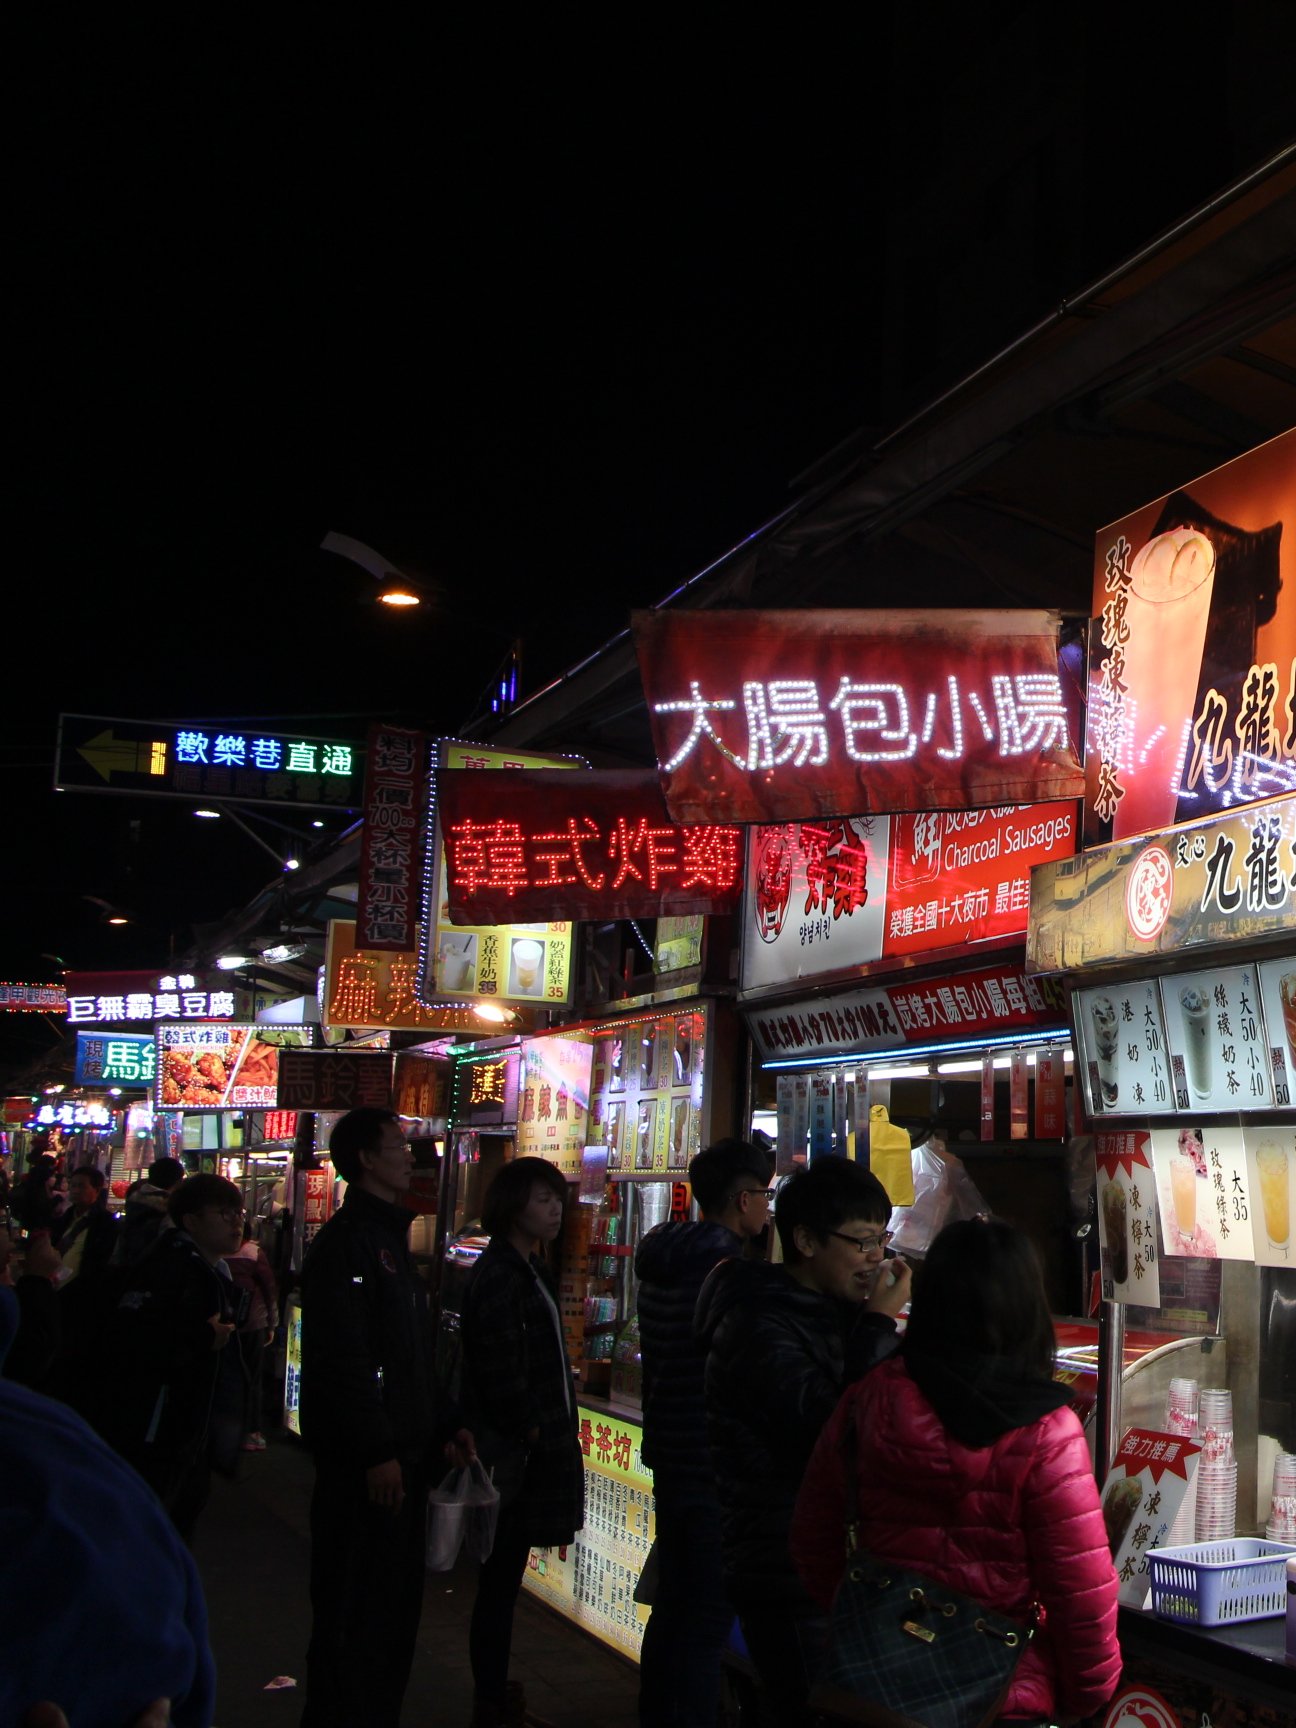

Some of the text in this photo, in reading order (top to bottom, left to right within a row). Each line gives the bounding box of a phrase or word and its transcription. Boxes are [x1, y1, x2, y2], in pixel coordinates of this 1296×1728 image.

[655, 674, 1069, 772] 大腸包小腸
[176, 732, 353, 777] 歡樂巷直通
[452, 818, 741, 896] 韓式炸雞
[944, 828, 1001, 871] Charcoal
[1004, 813, 1072, 854] Sausages
[798, 915, 832, 947] 양념치킨
[889, 887, 990, 939] 榮獲全國十大夜市
[480, 935, 499, 980] 香蕉牛奶
[67, 991, 236, 1023] 巨無霸臭豆腐
[479, 981, 498, 995] 35
[548, 986, 565, 999] 35
[1121, 999, 1145, 1106] 港奶凍
[1271, 1049, 1291, 1105] 熱 50
[1176, 1090, 1190, 1109] 50
[1210, 1148, 1231, 1240] 玫瑰綠茶
[1128, 1183, 1146, 1281] 凍檸茶
[1120, 1435, 1182, 1463] 強力推薦
[1118, 1491, 1162, 1582] 凍檸茶
